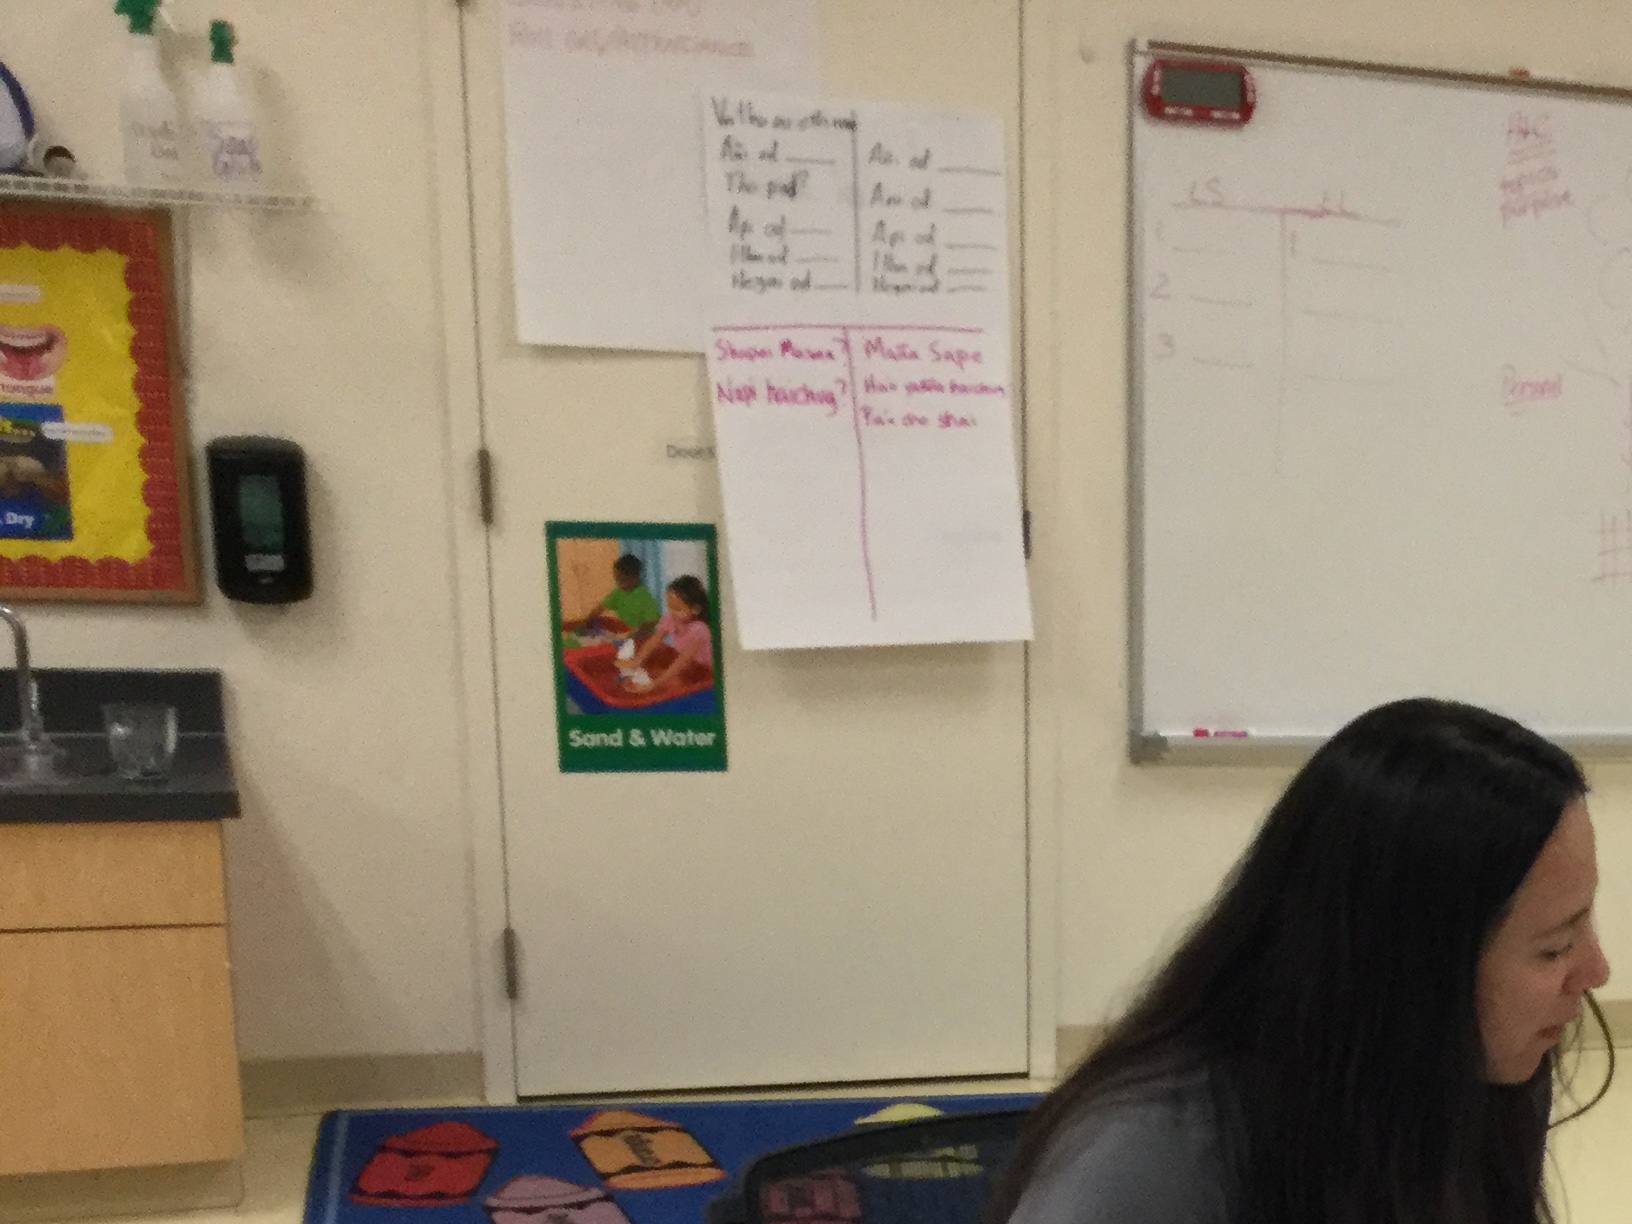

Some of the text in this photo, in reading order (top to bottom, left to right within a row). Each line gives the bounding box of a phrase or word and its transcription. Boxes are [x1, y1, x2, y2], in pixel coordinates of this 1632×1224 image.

[568, 727, 717, 748] Sand & Water
